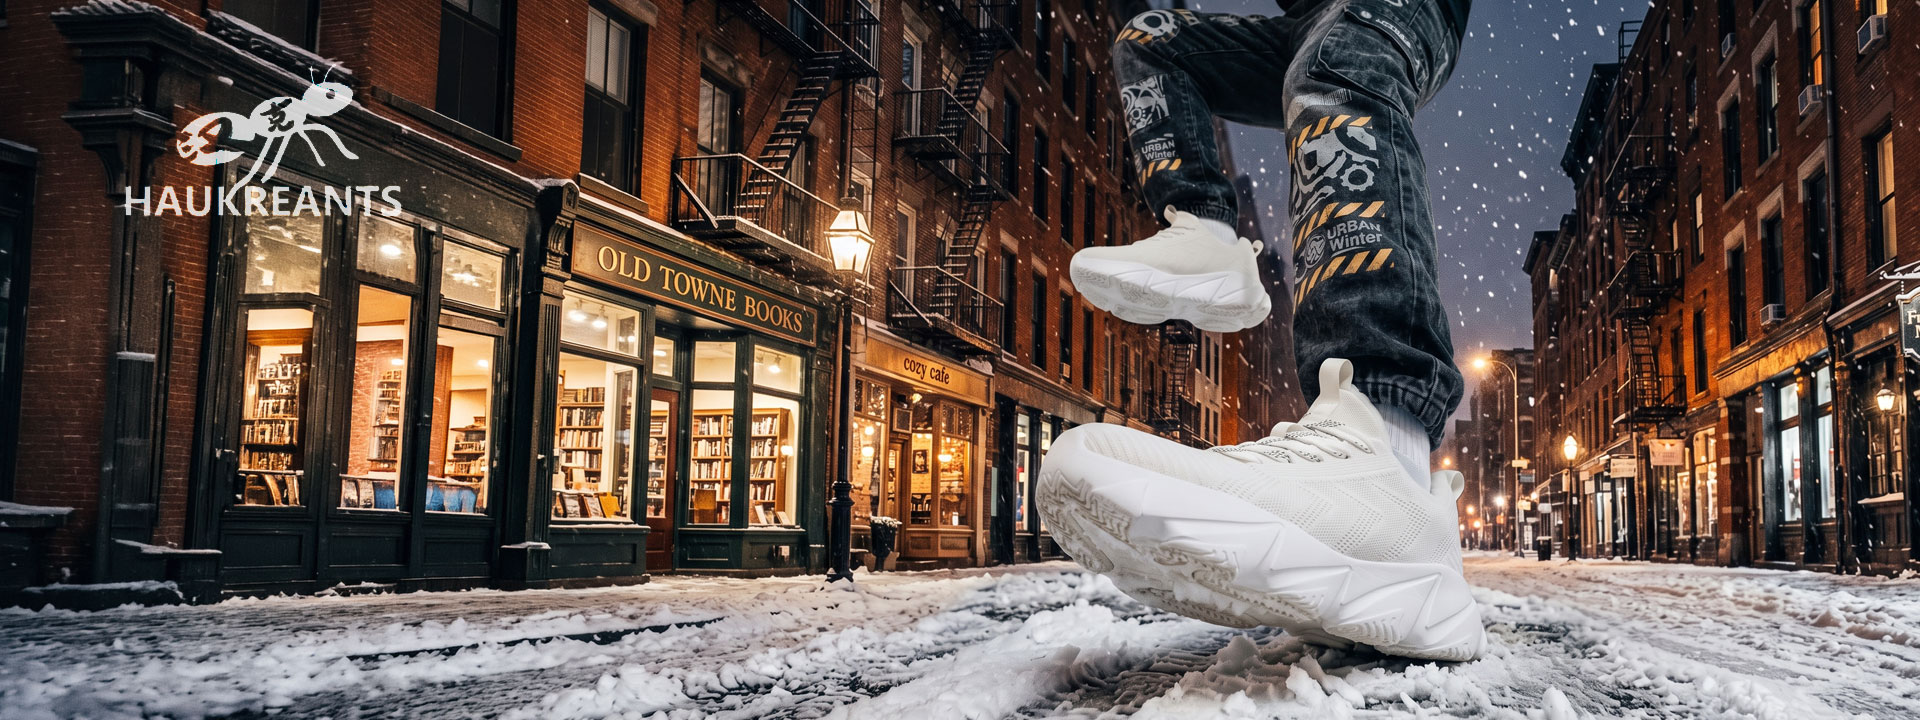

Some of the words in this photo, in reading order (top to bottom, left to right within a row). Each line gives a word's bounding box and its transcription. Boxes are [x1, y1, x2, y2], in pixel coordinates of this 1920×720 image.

[1141, 139, 1175, 154] URBAN
[1145, 150, 1176, 161] Winter
[1327, 220, 1380, 240] URBAN
[1329, 233, 1383, 252] Winter
[598, 246, 651, 282] OLD
[659, 265, 736, 312] TOWNE
[744, 295, 803, 333] BOOKS
[904, 357, 927, 380] cozy
[930, 366, 950, 385] cafe
